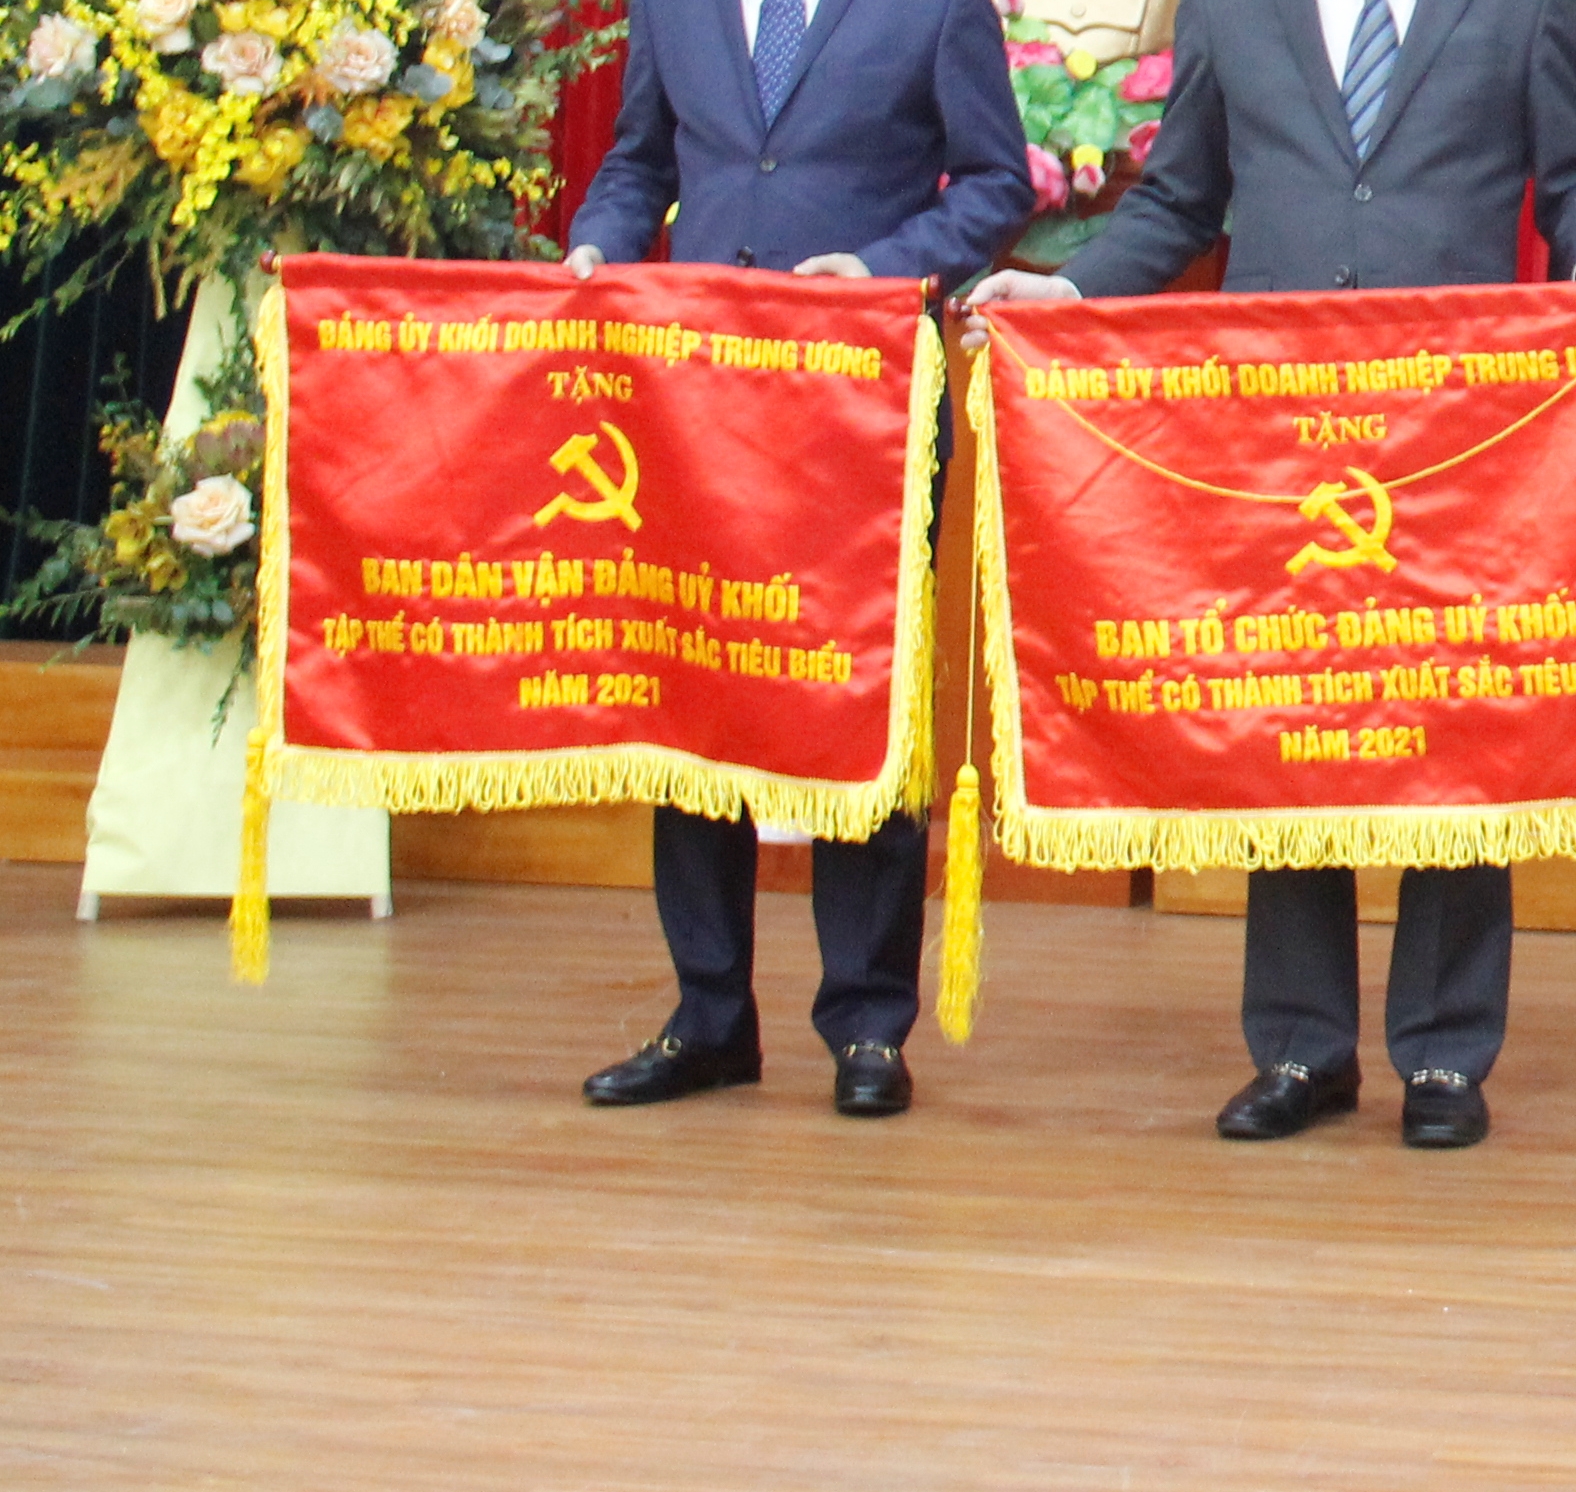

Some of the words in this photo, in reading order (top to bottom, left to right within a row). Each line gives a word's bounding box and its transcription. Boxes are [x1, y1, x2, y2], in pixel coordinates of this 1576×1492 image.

[318, 311, 392, 352] ĐẢNG
[399, 311, 432, 353] ỦY
[437, 313, 500, 353] KHỐI
[504, 319, 597, 352] DOANH
[604, 321, 701, 368] NGHIỆP
[710, 333, 798, 371] TRUNG
[804, 339, 882, 380] ƯƠNG
[547, 366, 633, 403] TẶNG
[1025, 359, 1109, 400] ĐẢNG
[1116, 357, 1154, 399] ỦY
[1162, 354, 1232, 400] KHỐI
[1238, 362, 1340, 398] DOANH
[1345, 349, 1452, 395] NGHIỆP
[1460, 349, 1560, 386] TRUNG
[1293, 411, 1387, 449] TẶNG
[361, 557, 423, 596] BAN
[430, 551, 503, 599] DÂN
[512, 551, 584, 607] VẬN
[593, 547, 675, 604] ĐẢNG
[721, 572, 800, 622] KHỐI
[323, 612, 364, 658] TẬP
[366, 609, 406, 653] THỂ
[410, 616, 444, 653] CÓ
[451, 616, 544, 655] THÀNH
[551, 612, 614, 651] TÍCH
[620, 616, 678, 657] XUẤT
[681, 625, 722, 671] SẮC
[726, 637, 781, 678] TIÊU
[789, 639, 852, 684] BIỂU
[1094, 620, 1171, 658] BAN
[1178, 597, 1227, 655] TỔ
[1234, 604, 1329, 654] CHỨC
[1336, 596, 1436, 648] ĐẢNG
[519, 669, 589, 709] NĂM
[596, 673, 661, 707] 2021
[1055, 671, 1099, 715] TẬP
[1102, 668, 1156, 714] THỂ
[1161, 673, 1201, 713] CÓ
[1207, 669, 1302, 710] THÀNH
[1307, 667, 1374, 703] TÍCH
[1380, 657, 1450, 701] XUẤT
[1457, 654, 1514, 699] SẮC
[1280, 724, 1351, 763] NĂM
[1358, 726, 1427, 760] 2021
